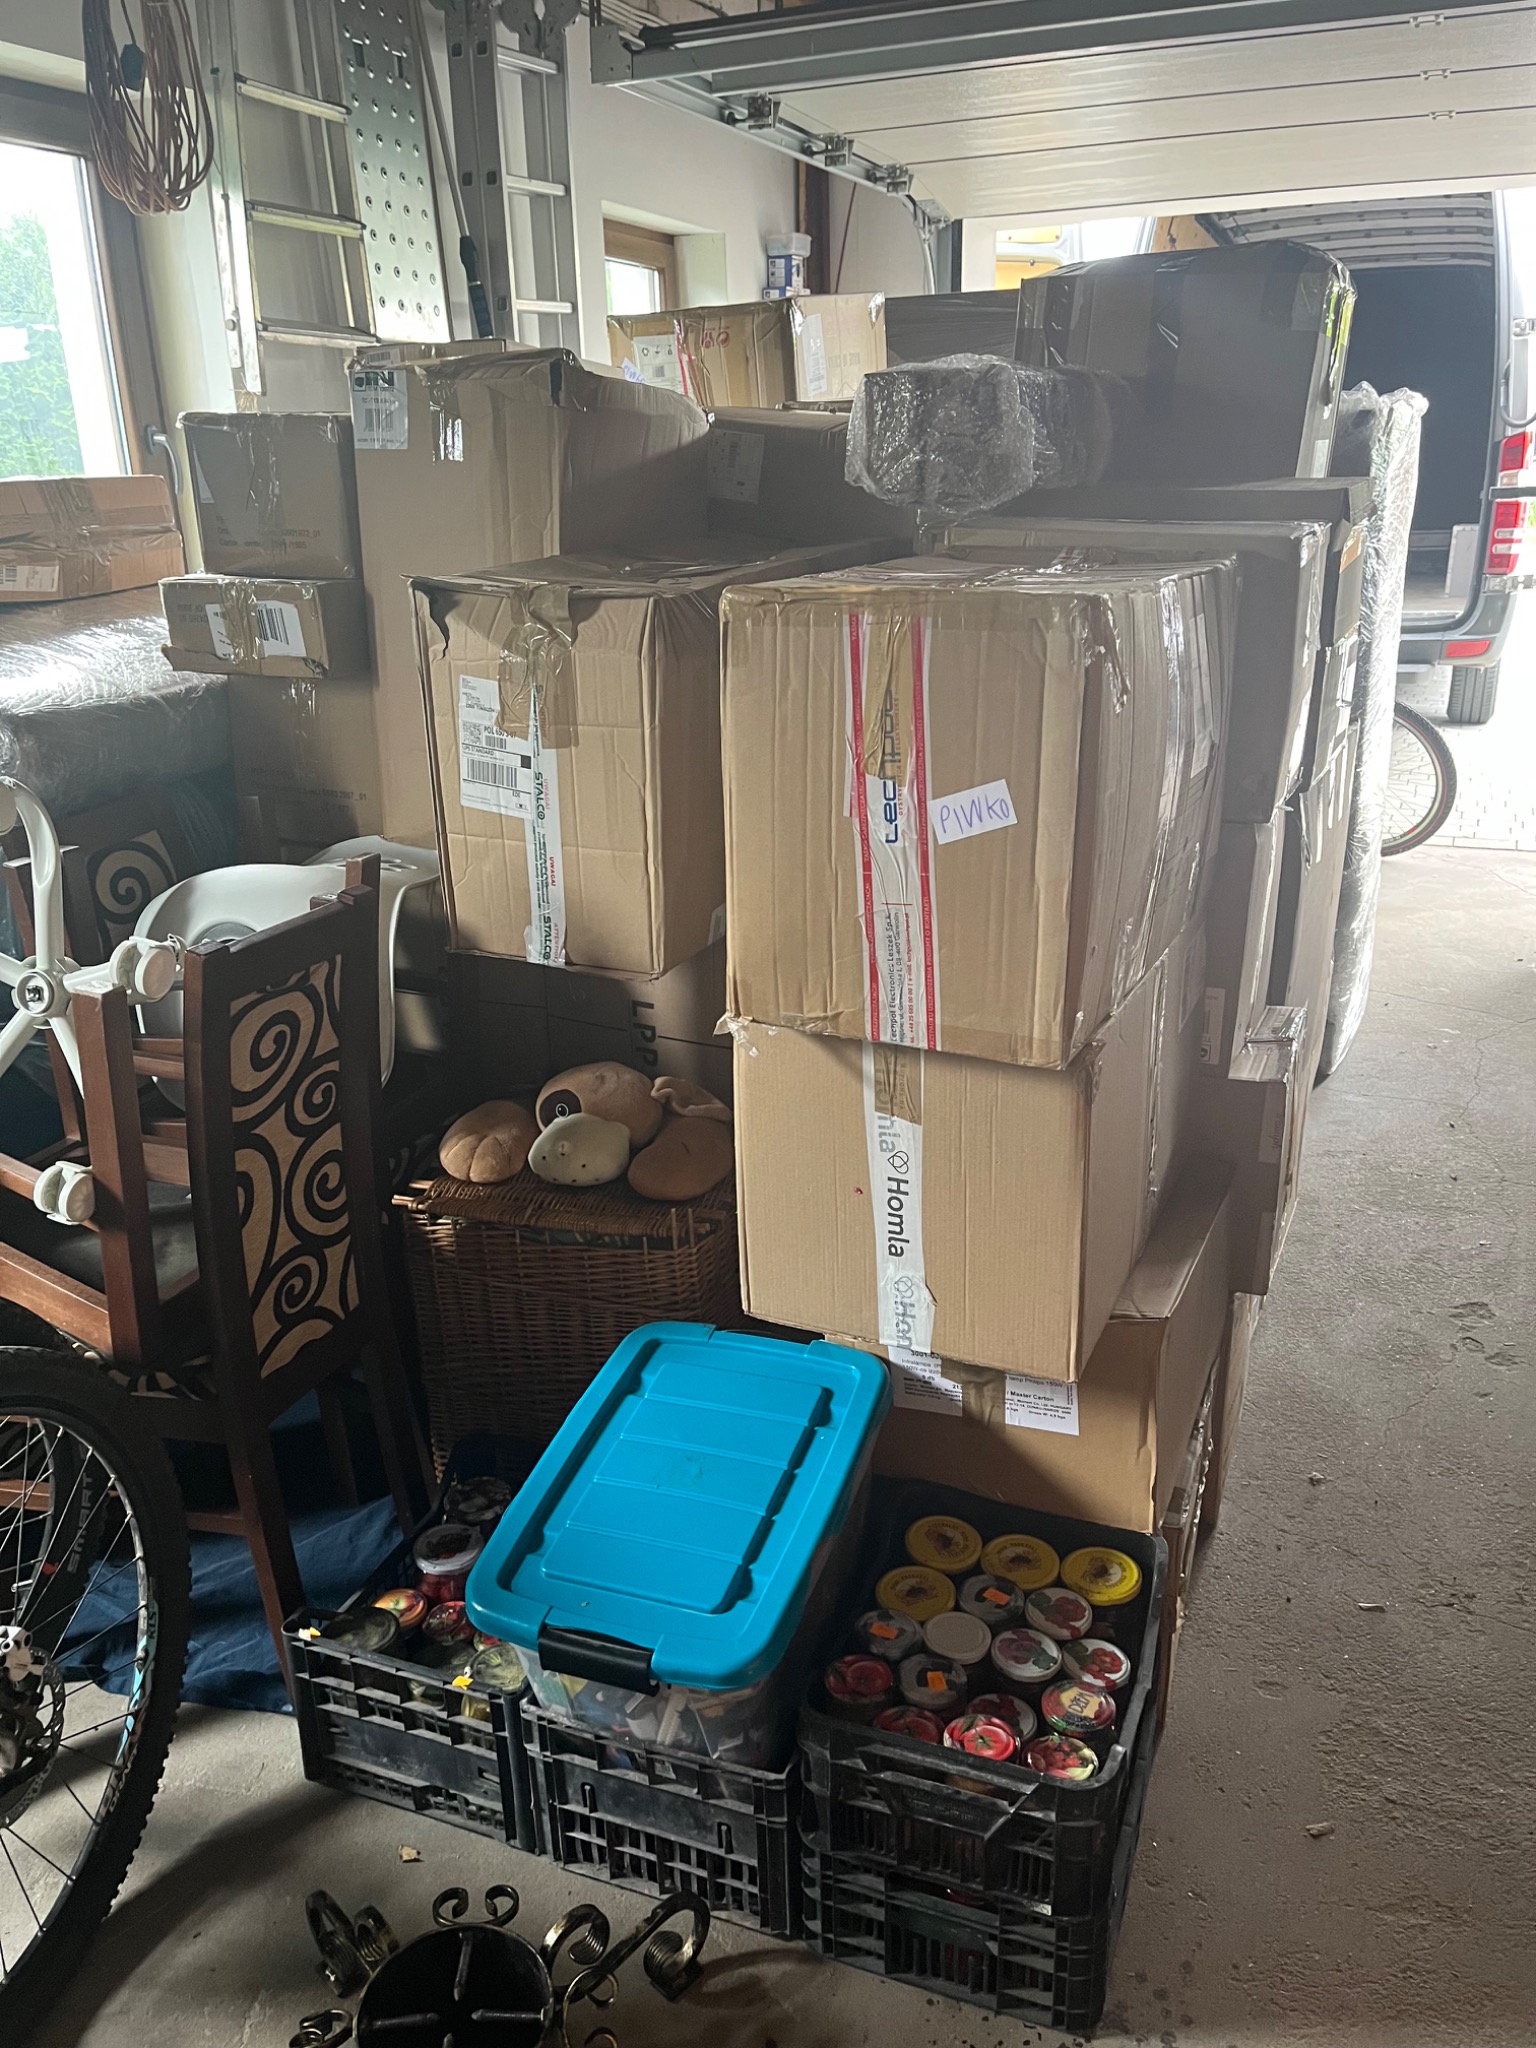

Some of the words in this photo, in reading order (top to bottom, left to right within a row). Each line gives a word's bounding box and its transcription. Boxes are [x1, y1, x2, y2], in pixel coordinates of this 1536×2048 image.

[484, 725, 495, 735] POL
[471, 747, 495, 757] STANDARD
[535, 772, 545, 821] STALCO
[940, 794, 1010, 834] PIWKO
[543, 915, 552, 960] STALCO
[885, 934, 894, 962] Leszek
[924, 936, 932, 966] PROSIMY
[632, 999, 659, 1067] LPP
[886, 1174, 910, 1259] Homla
[1010, 1390, 1032, 1399] Master
[1033, 1394, 1055, 1402] Carton
[67, 1472, 93, 1574] SMART
[1068, 1691, 1094, 1714] DŻEM
